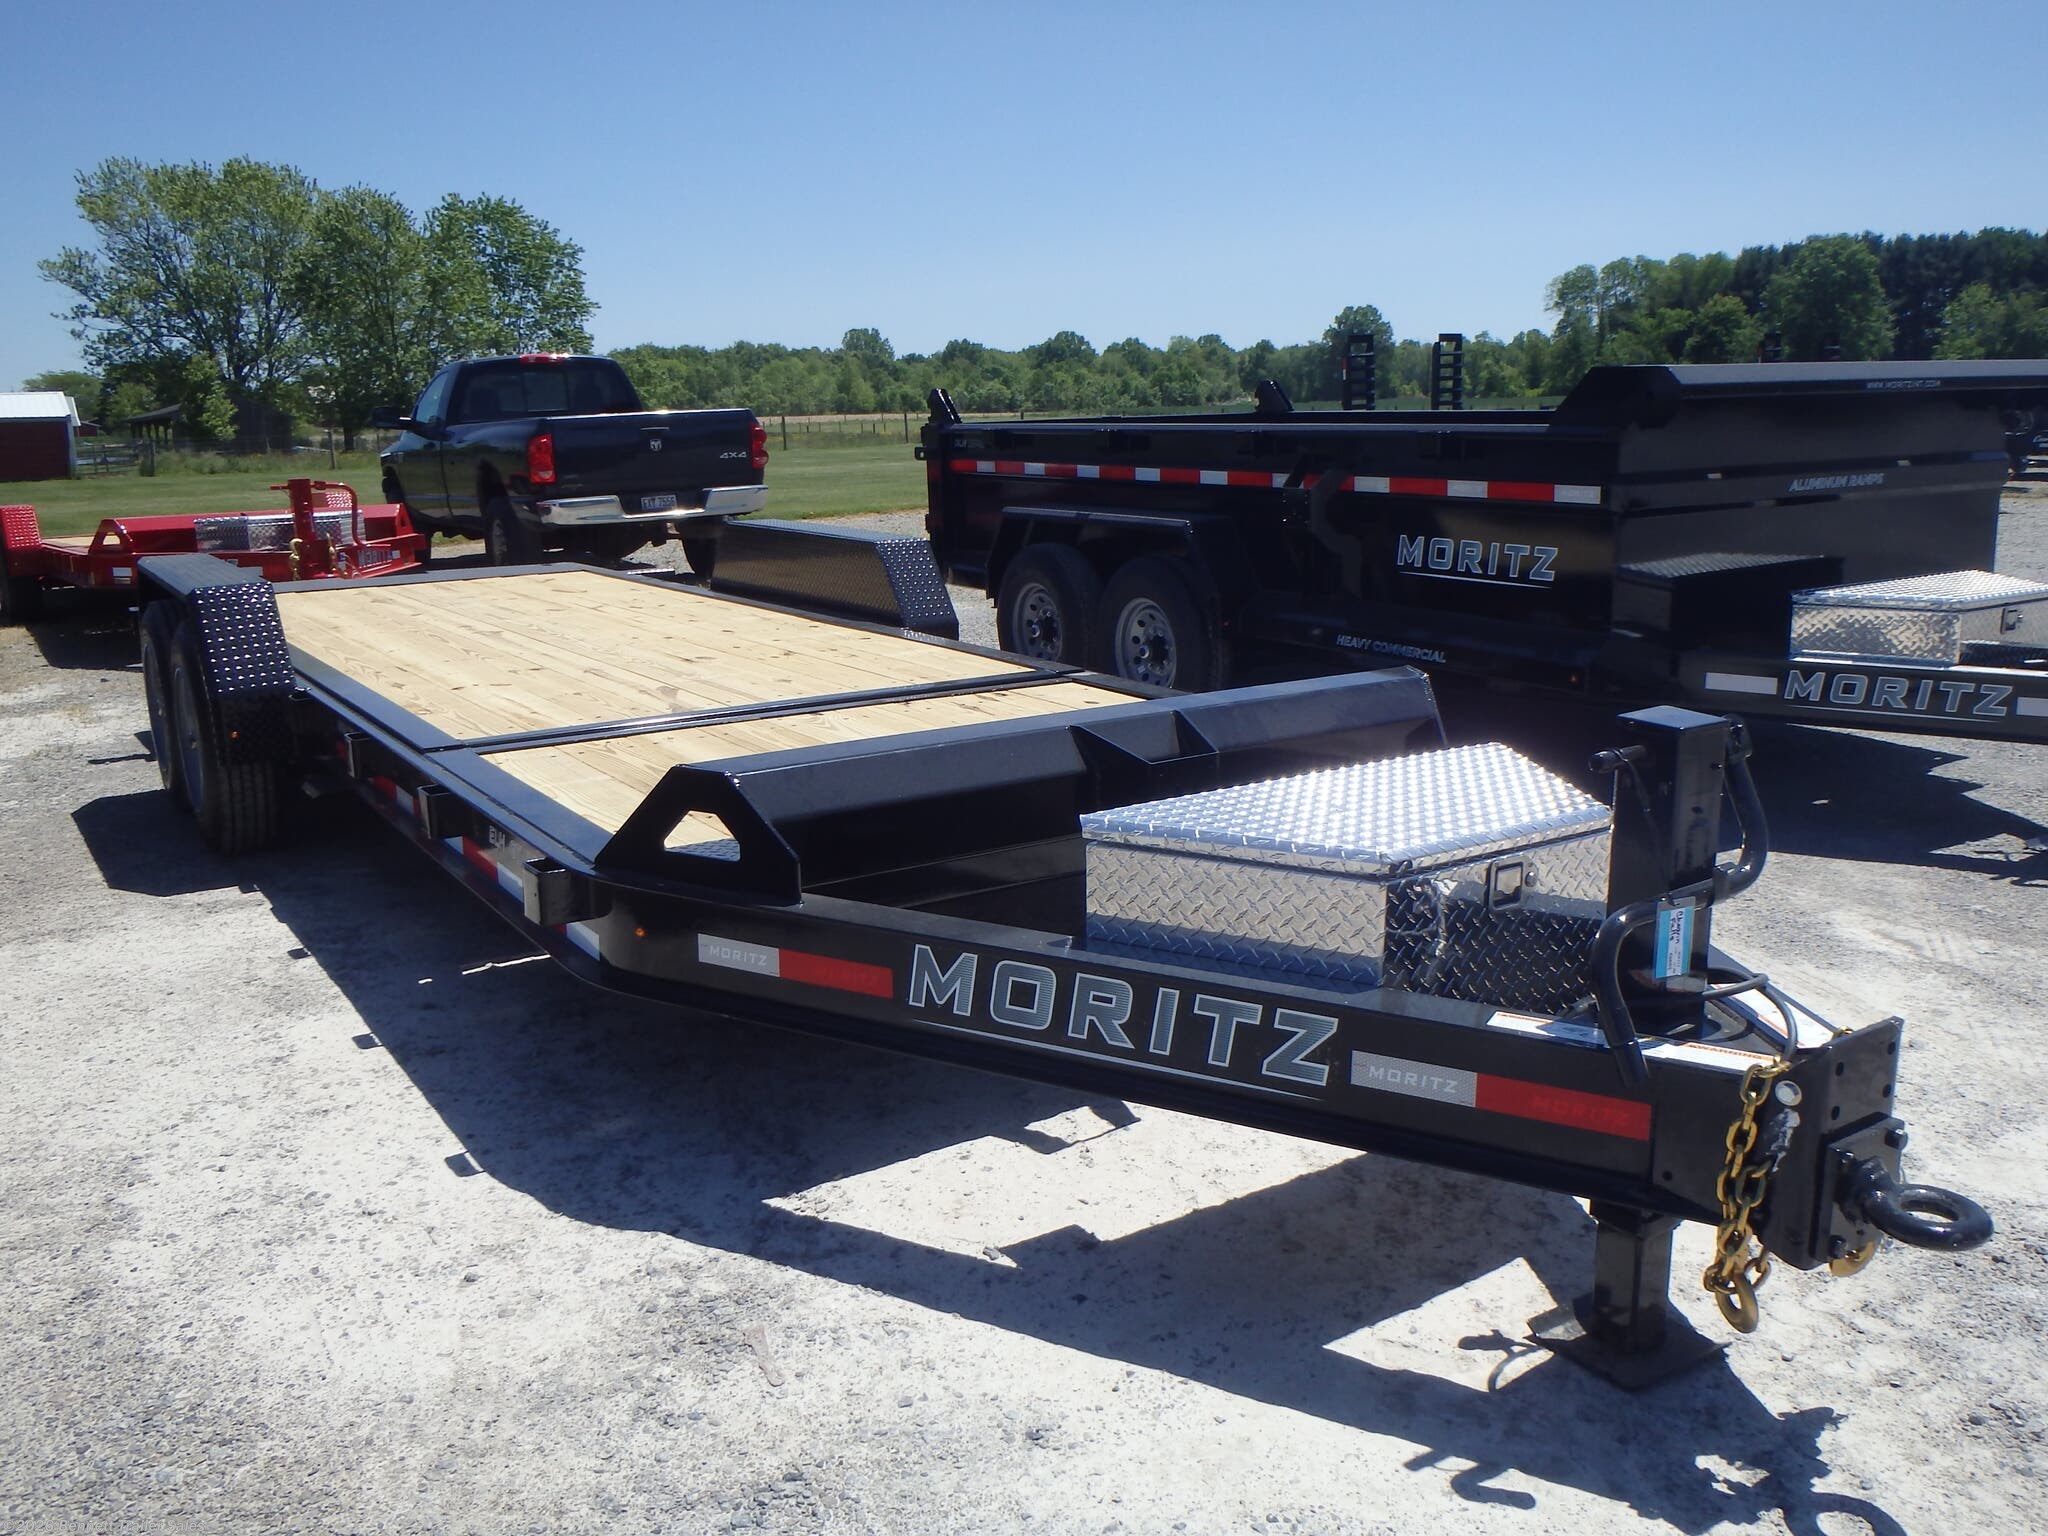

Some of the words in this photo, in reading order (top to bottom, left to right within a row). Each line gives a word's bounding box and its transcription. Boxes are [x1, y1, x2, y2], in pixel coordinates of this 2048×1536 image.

[1788, 475, 1849, 491] ALUMINUM
[1397, 535, 1558, 581] MORITZ
[1336, 634, 1371, 649] HEAVY
[1372, 641, 1446, 663] COMMERCIAL
[1784, 670, 2013, 716] MORITZ
[709, 944, 768, 967] MORITZ
[908, 943, 1340, 1087] MORITZ
[1368, 1065, 1458, 1094] MORITZ
[1529, 1096, 1630, 1127] MORITZ
